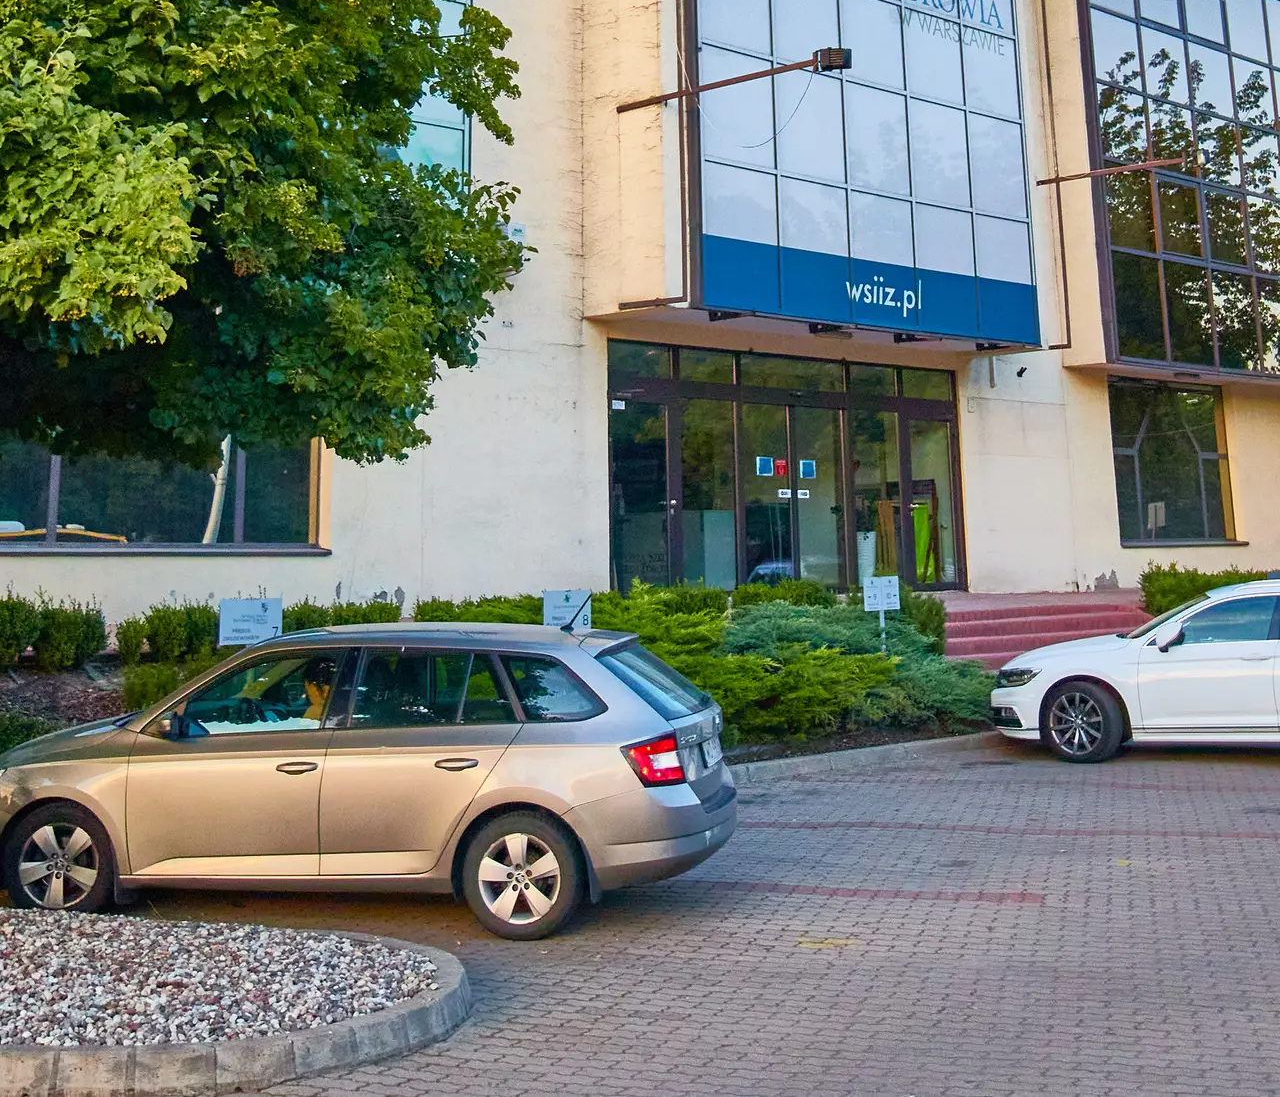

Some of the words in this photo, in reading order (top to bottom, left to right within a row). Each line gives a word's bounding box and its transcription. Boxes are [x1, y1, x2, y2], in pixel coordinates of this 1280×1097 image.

[845, 275, 922, 318] wsiiz.pl
[582, 614, 589, 626] 8
[271, 626, 279, 637] 7
